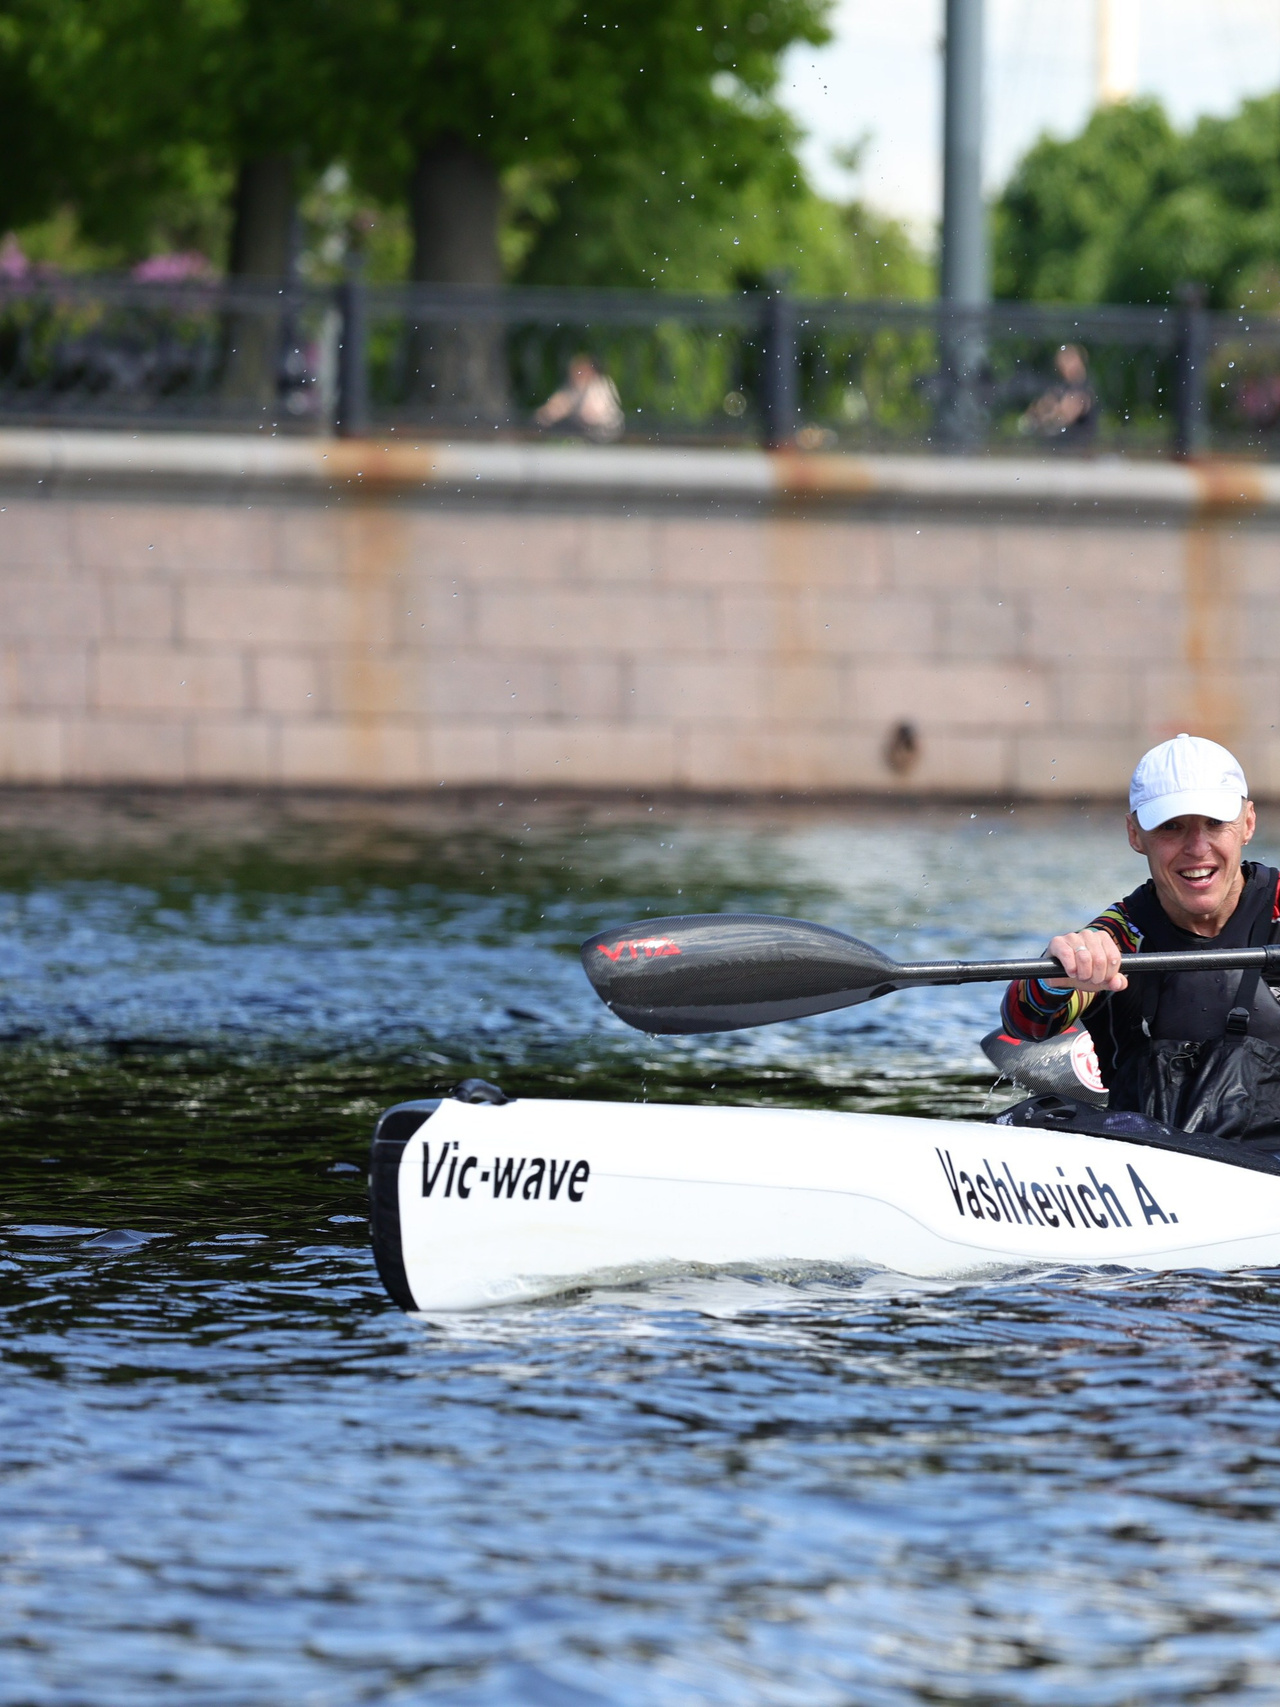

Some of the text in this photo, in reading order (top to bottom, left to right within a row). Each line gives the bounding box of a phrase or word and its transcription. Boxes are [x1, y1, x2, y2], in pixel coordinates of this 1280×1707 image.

[596, 936, 682, 962] VITA
[422, 1141, 590, 1202] Vic-wave
[934, 1147, 1179, 1229] Vashkevich A.
